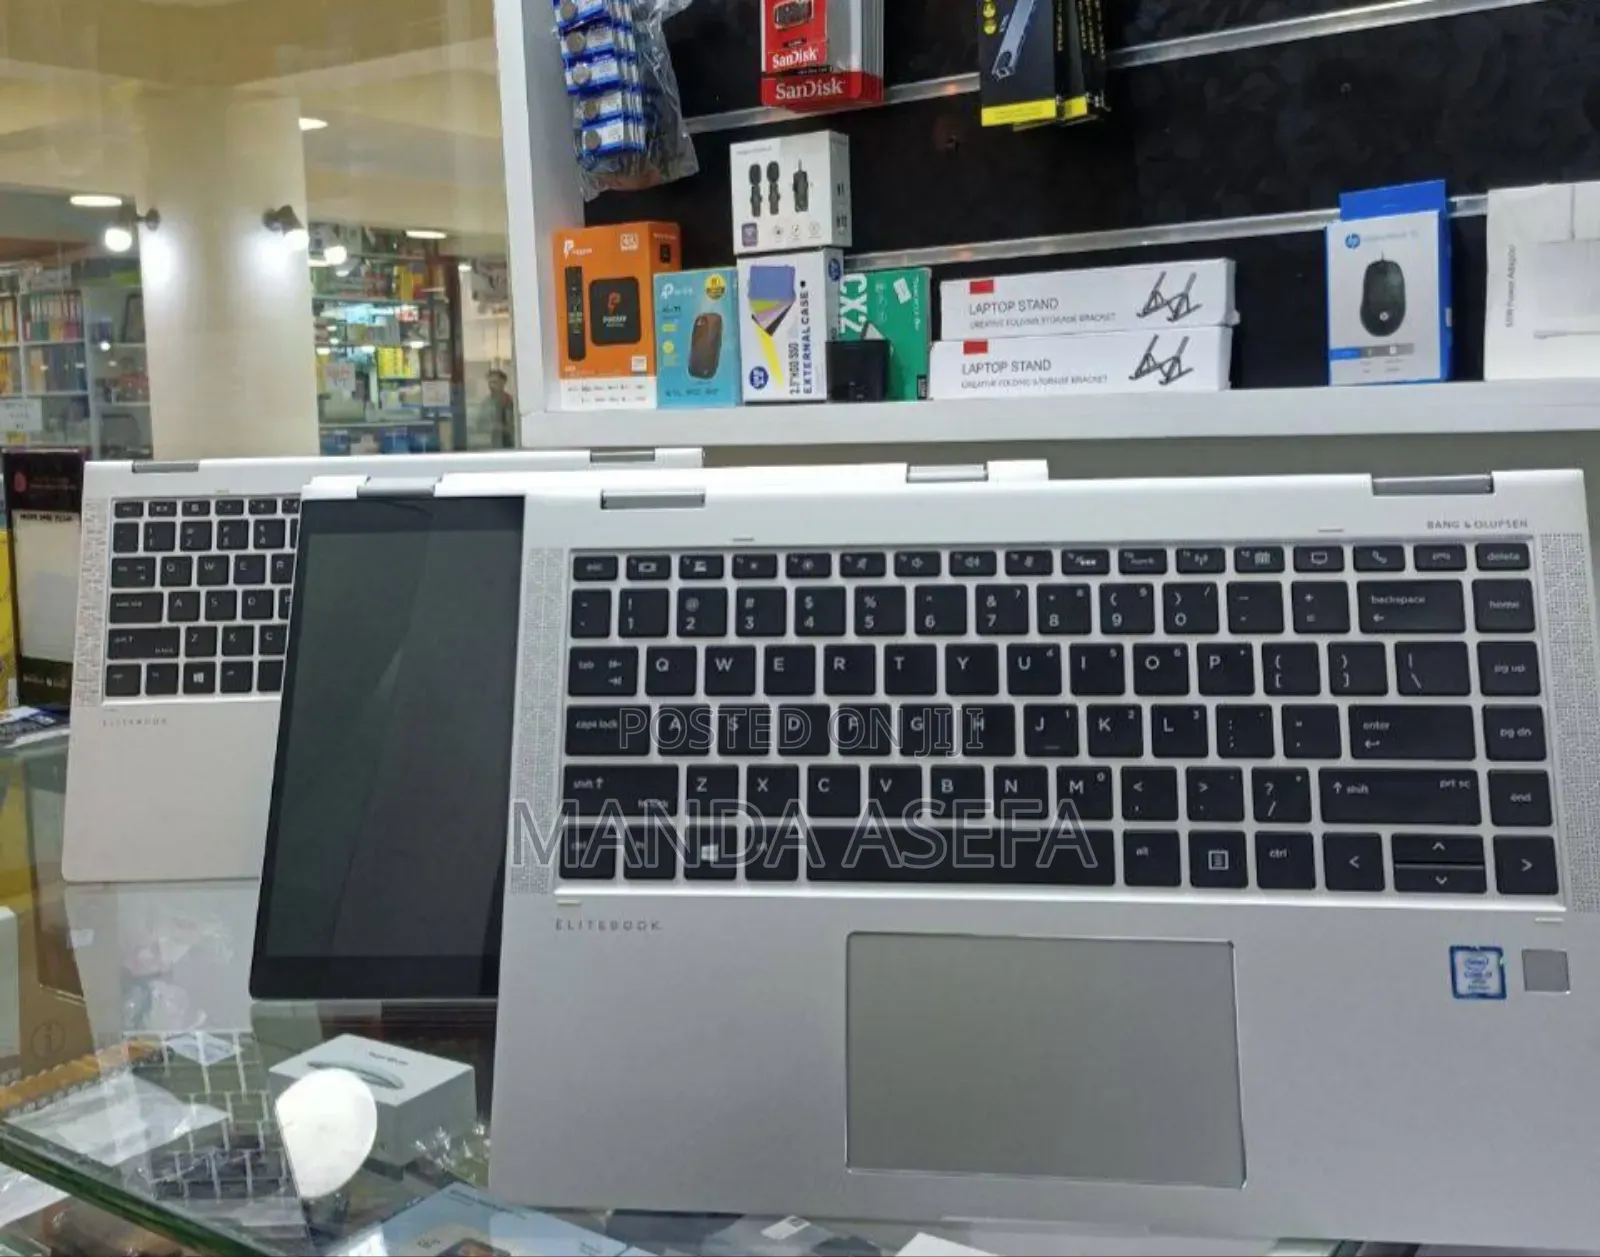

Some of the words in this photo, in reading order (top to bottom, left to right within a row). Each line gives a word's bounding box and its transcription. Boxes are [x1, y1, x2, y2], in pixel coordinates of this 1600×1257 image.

[772, 47, 818, 68] SanDisk
[775, 78, 844, 100] SanDisk
[800, 290, 809, 325] CASE
[969, 300, 1015, 316] LAPTOP
[1018, 297, 1059, 313] STAND
[801, 325, 812, 394] EXTERNAL
[962, 361, 1008, 376] LAPTOP
[1011, 358, 1052, 373] STAND
[1427, 521, 1460, 529] BANG
[1487, 552, 1520, 561] delete
[864, 596, 876, 608] %
[1371, 596, 1425, 604] backspace
[628, 617, 633, 629] 1
[686, 617, 695, 630] 2
[746, 616, 754, 629] 3
[805, 616, 814, 628] 4
[865, 616, 874, 628] 5
[925, 615, 935, 628] 6
[988, 614, 996, 627] 7
[1049, 614, 1059, 627] 8
[1112, 613, 1122, 626] 9
[579, 661, 594, 669] tab
[656, 658, 669, 671] Q
[716, 658, 733, 671] W
[774, 658, 784, 671] E
[834, 657, 845, 670] R
[895, 657, 904, 670] T
[958, 657, 968, 670] Y
[1018, 656, 1030, 670] U
[1210, 656, 1220, 668] P
[575, 718, 597, 730] caps
[1035, 717, 1044, 731] J
[1099, 718, 1110, 731] K
[1163, 718, 1174, 732] L
[1363, 721, 1389, 729] enter
[574, 780, 592, 788] shift
[697, 778, 707, 791] Z
[758, 779, 768, 791] X
[818, 778, 829, 792] C
[880, 779, 892, 792] V
[942, 779, 953, 792] B
[1005, 780, 1017, 792] N
[1070, 781, 1083, 793] M
[1266, 783, 1273, 795] ?
[1347, 785, 1368, 793] shift
[1440, 780, 1455, 788] prt
[1510, 793, 1531, 802] end
[1270, 849, 1287, 857] ctrl
[555, 919, 662, 932] ELITEBOOK
